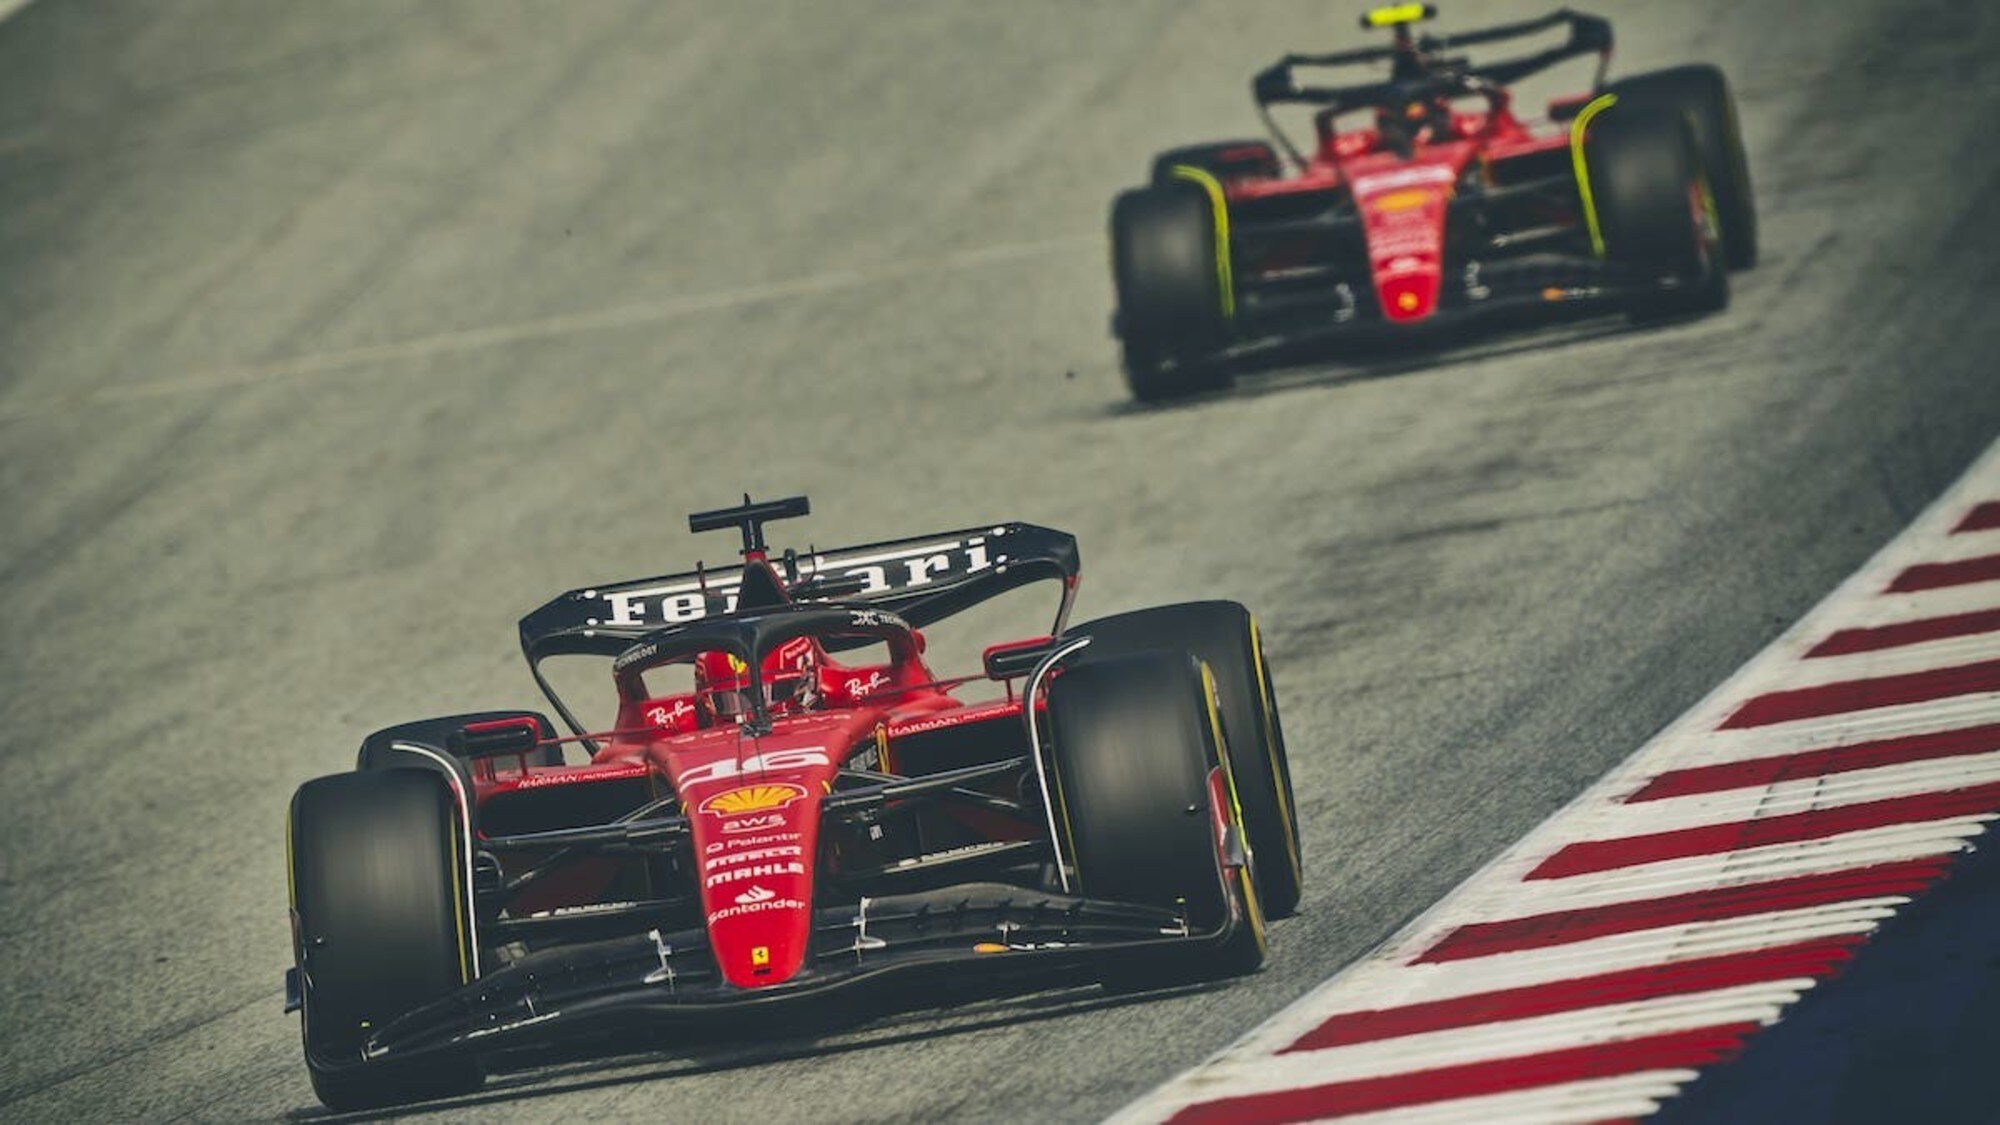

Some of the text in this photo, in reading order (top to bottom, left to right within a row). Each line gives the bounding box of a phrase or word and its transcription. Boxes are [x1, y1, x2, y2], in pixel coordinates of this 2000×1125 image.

[603, 537, 992, 626] Feari
[677, 746, 830, 794] 16
[721, 813, 786, 832] aws
[727, 832, 802, 849] Palantir
[706, 862, 805, 888] MAHLE
